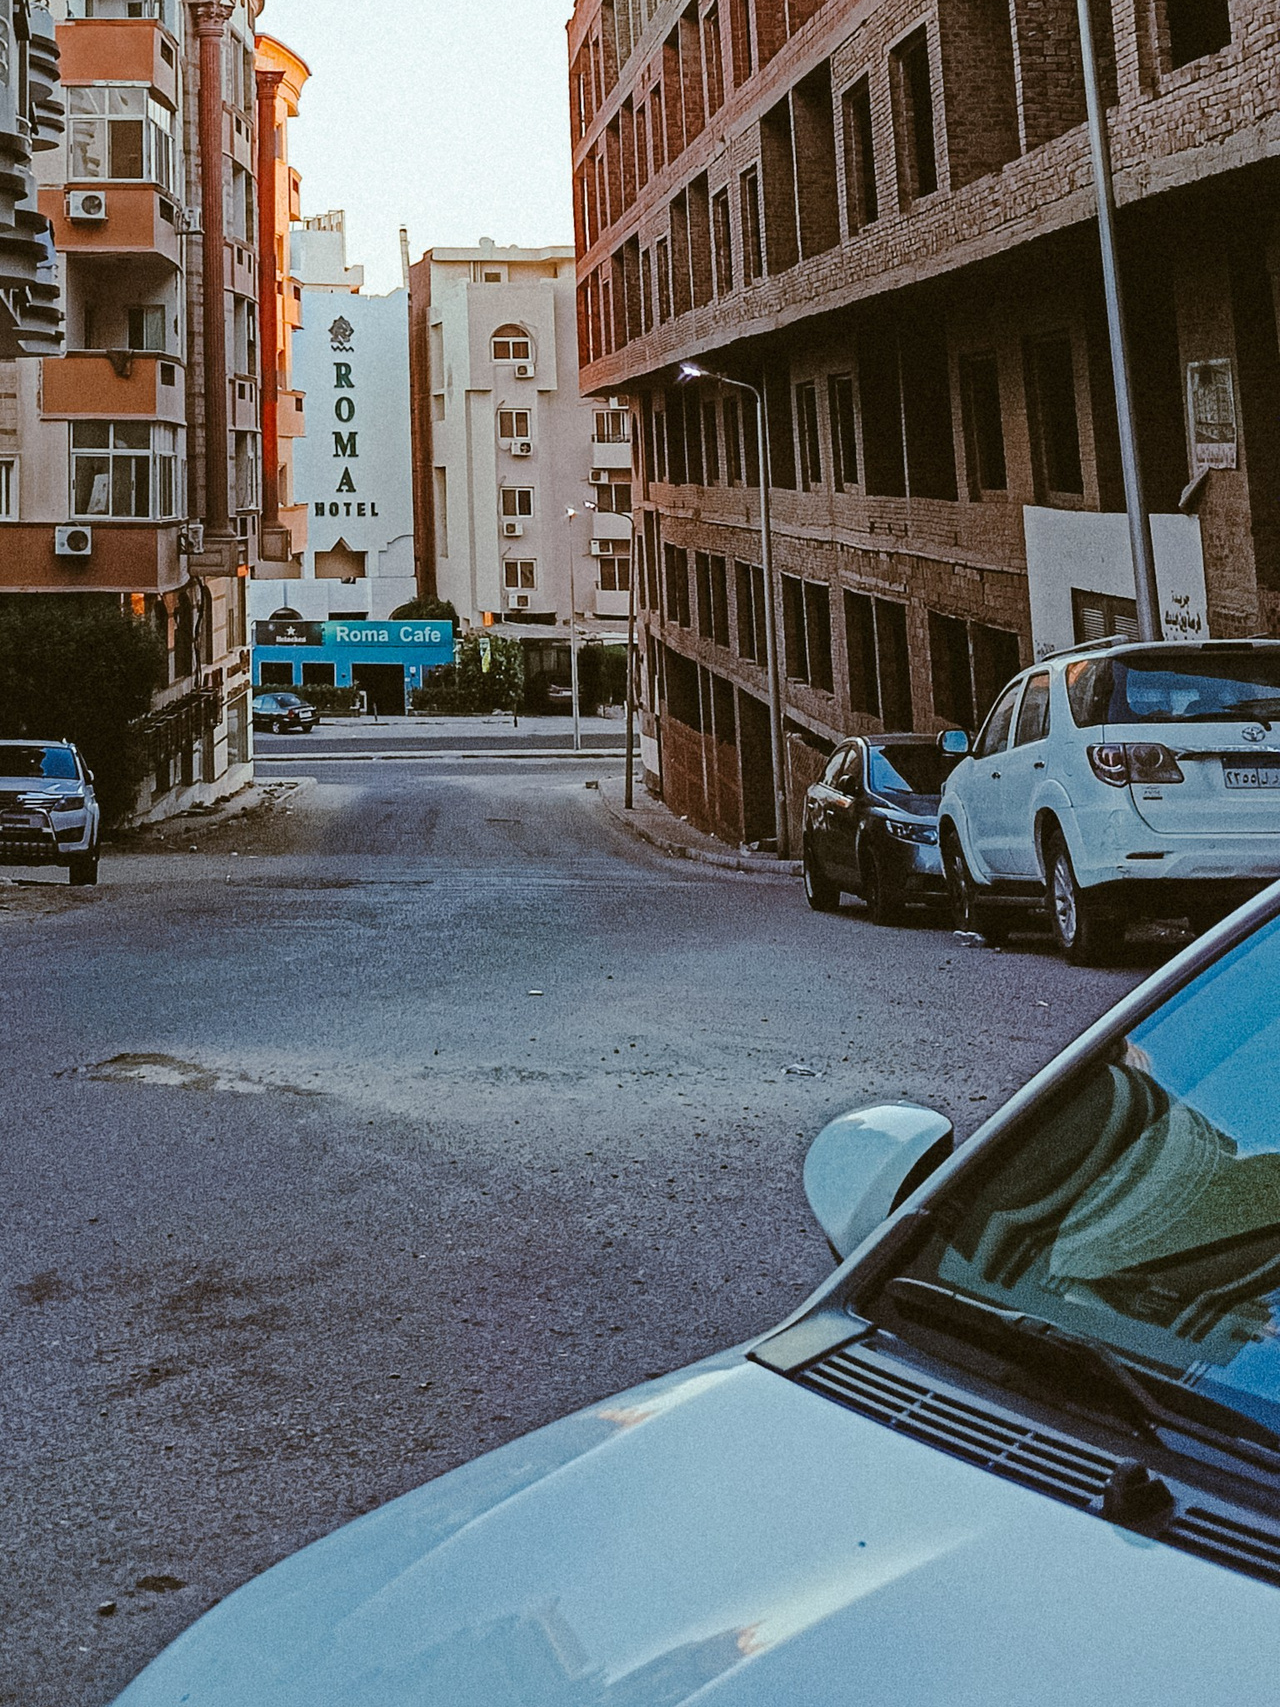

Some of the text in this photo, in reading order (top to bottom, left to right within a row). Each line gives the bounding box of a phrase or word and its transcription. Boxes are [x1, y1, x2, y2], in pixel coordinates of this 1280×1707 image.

[332, 362, 359, 493] ROMA
[314, 502, 379, 517] HOTEL
[336, 626, 441, 642] Roma Cafe
